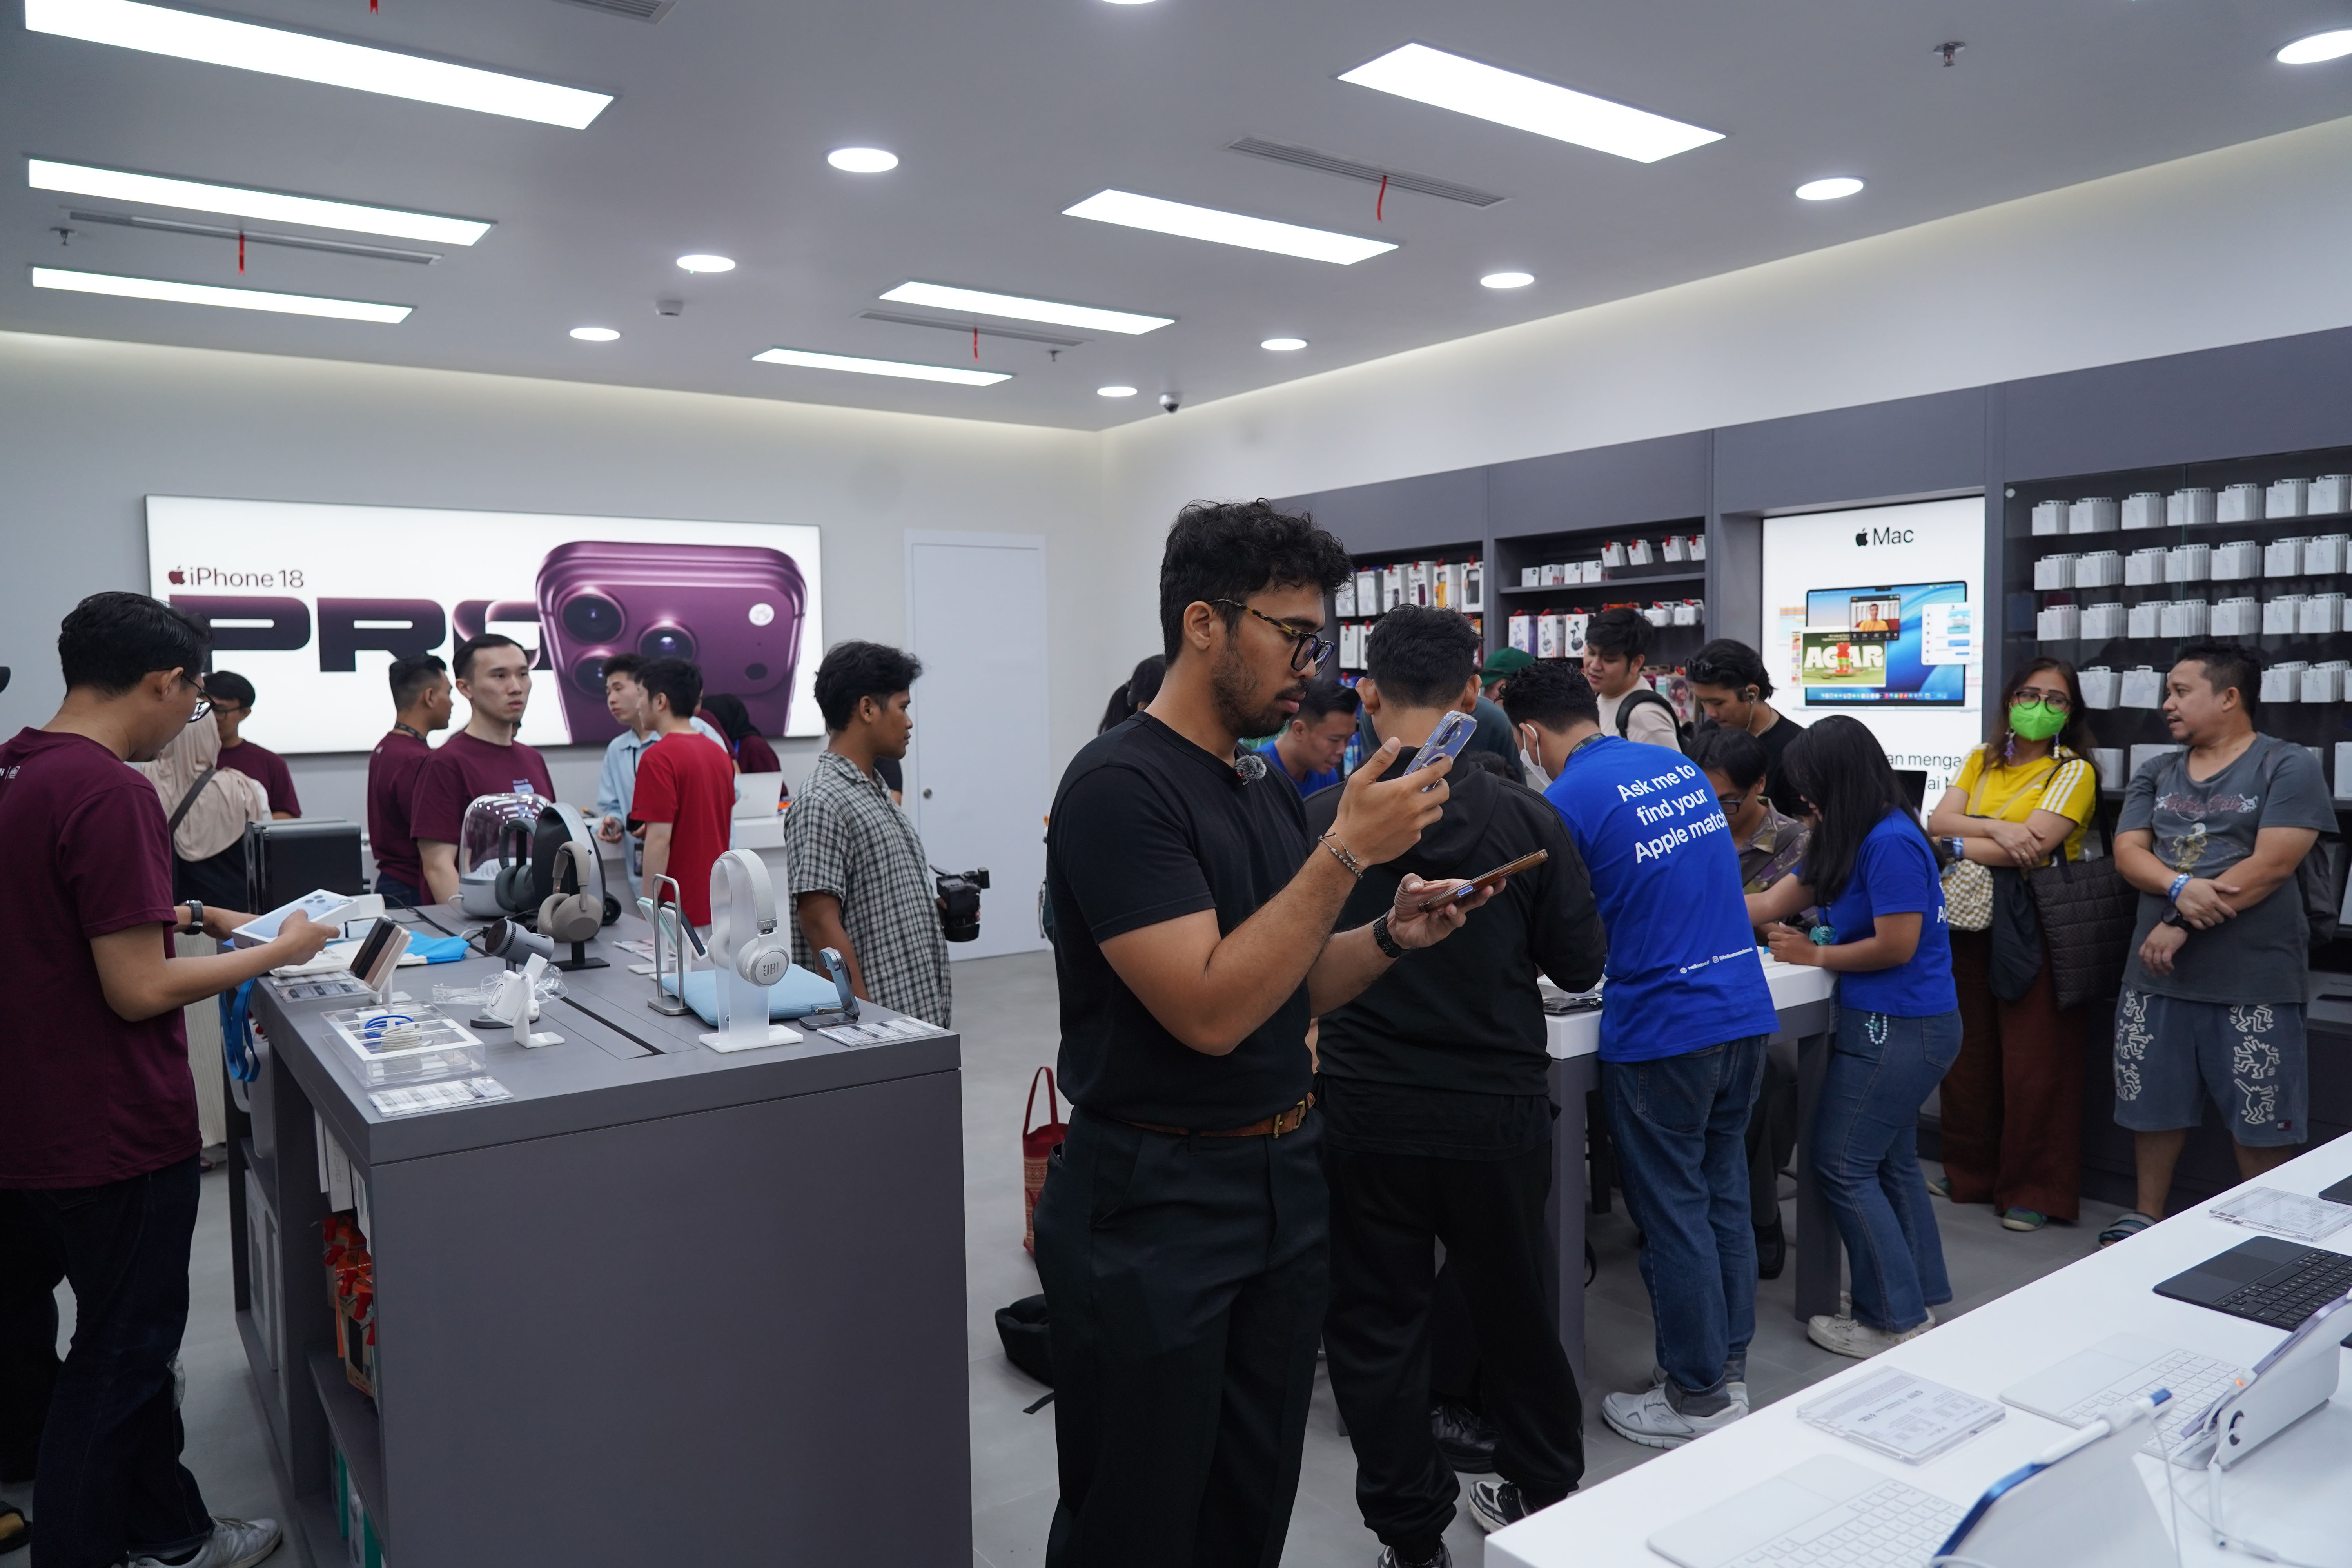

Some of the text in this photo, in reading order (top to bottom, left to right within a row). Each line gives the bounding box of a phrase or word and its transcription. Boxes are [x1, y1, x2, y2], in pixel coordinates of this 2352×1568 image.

[1873, 527, 1913, 545] Mac
[190, 567, 303, 588] iPhone 18
[1804, 645, 1884, 668] AGAR
[1908, 755, 1961, 770] menga
[1617, 765, 1696, 802] Ask me to
[1636, 789, 1708, 826] find your
[1635, 809, 1729, 864] Apple match
[763, 962, 779, 976] JBL
